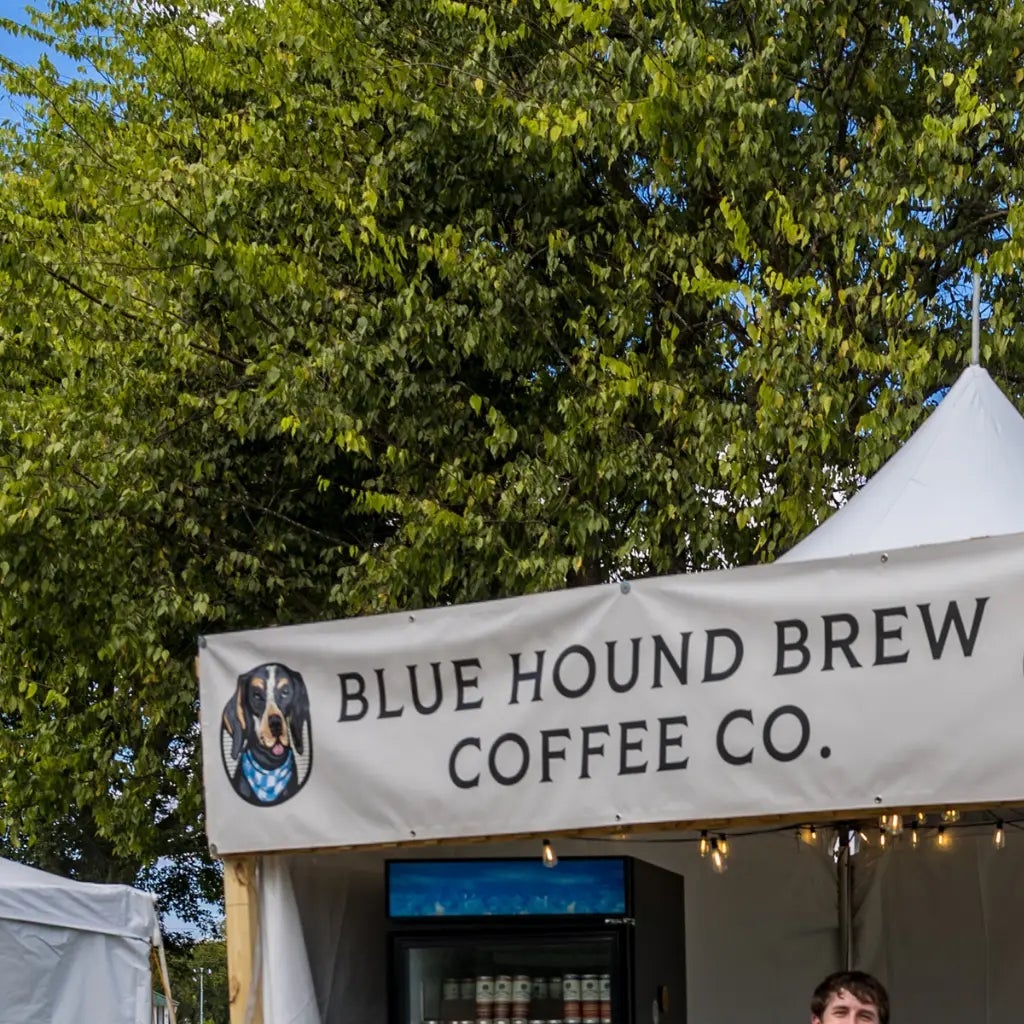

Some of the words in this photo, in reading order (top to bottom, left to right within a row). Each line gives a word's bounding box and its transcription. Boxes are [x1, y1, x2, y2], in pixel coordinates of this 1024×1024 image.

[337, 657, 484, 723] BLUE
[508, 628, 745, 705] HOUND
[773, 596, 991, 677] BREW
[449, 715, 690, 789] COFFEE
[716, 704, 832, 766] CO.
